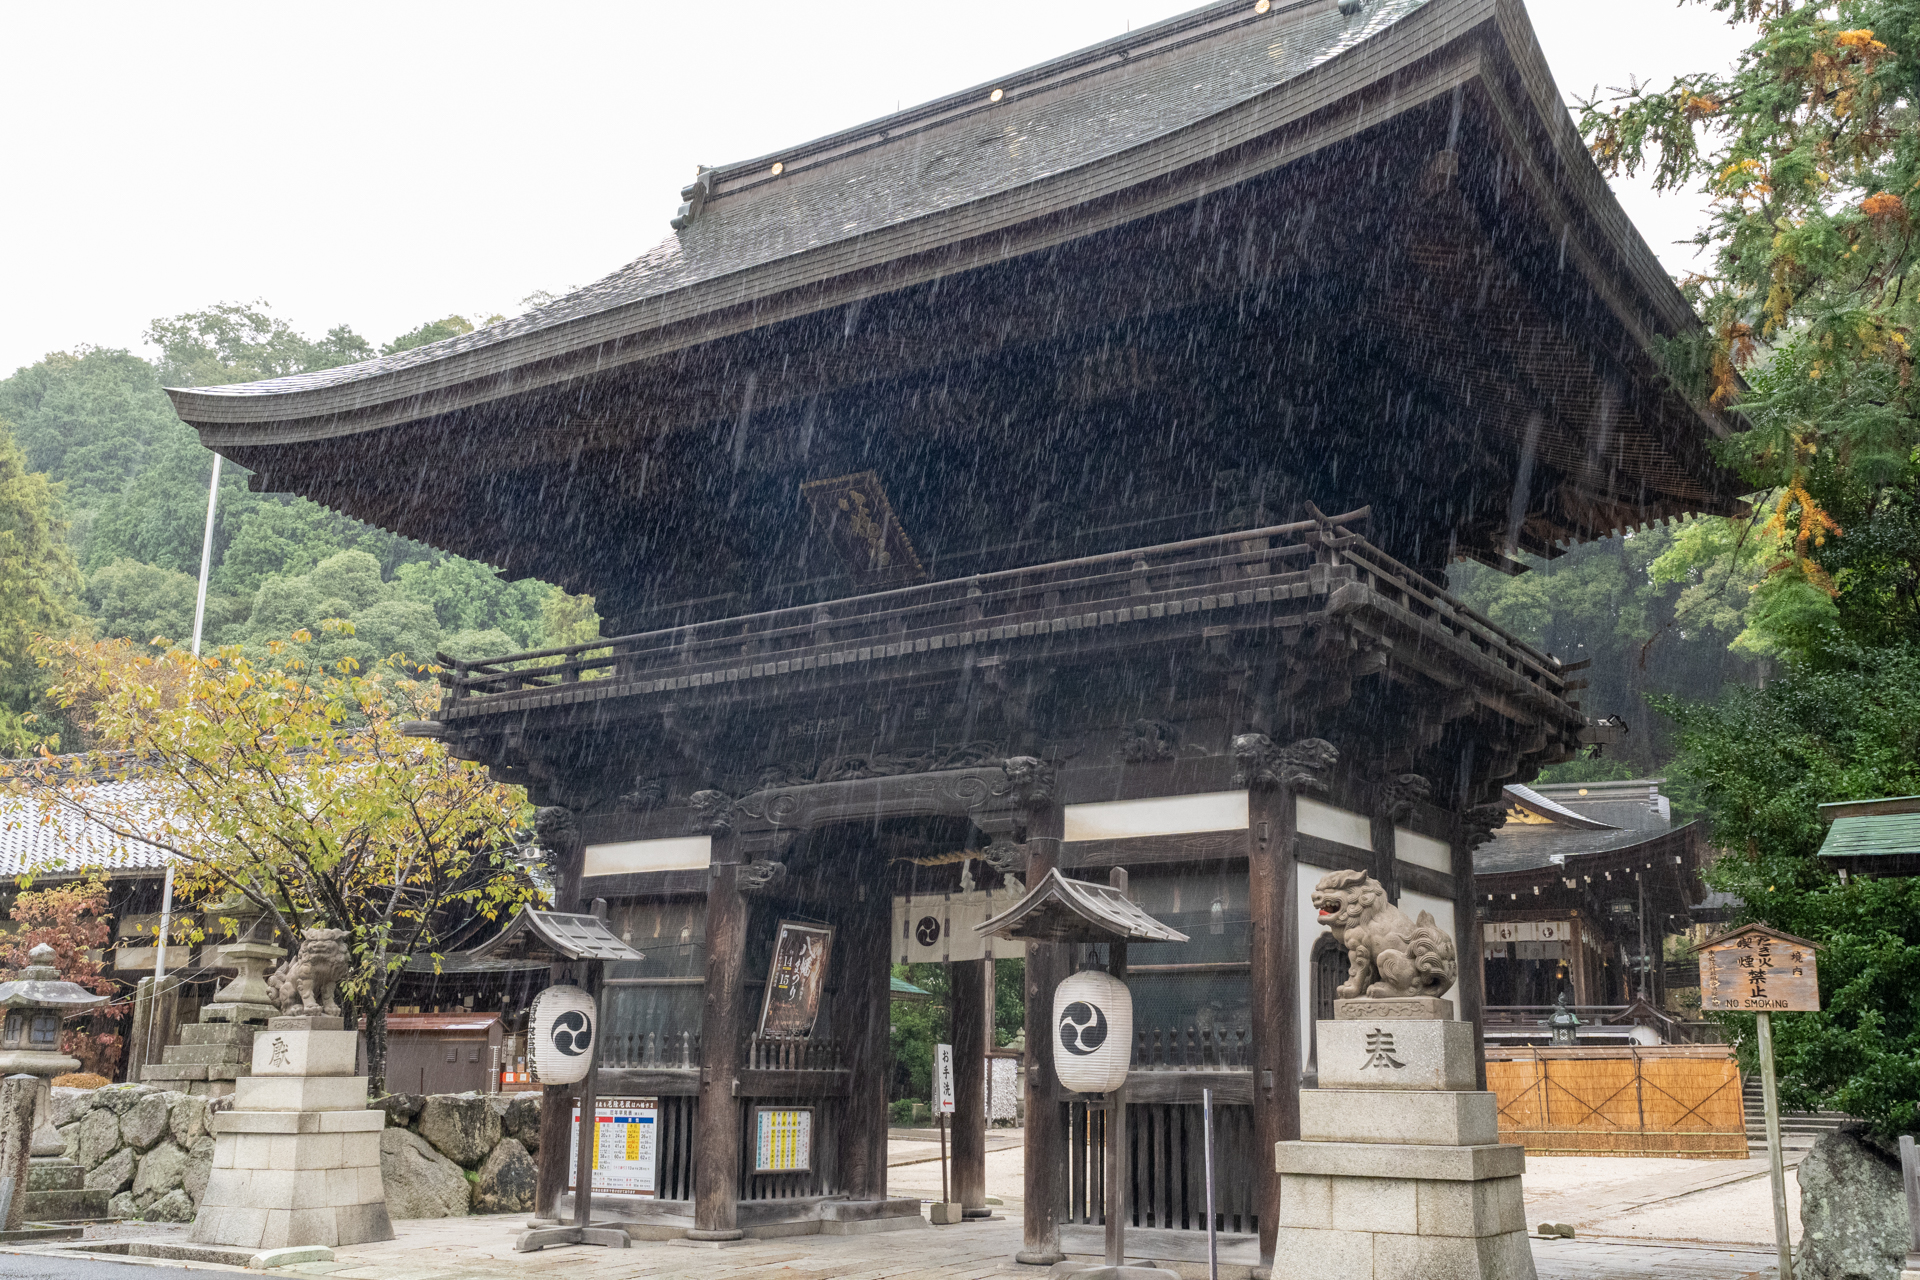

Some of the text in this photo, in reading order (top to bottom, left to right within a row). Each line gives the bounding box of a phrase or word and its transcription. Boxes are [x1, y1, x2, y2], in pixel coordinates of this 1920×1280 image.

[783, 956, 792, 967] 14
[1737, 937, 1754, 968] 喫煙
[1757, 935, 1774, 968] たき火
[1791, 951, 1803, 976] 境内
[779, 974, 789, 985] 15
[1748, 969, 1767, 998] 禁止
[1726, 999, 1789, 1009] NO SMOKING
[1359, 1028, 1407, 1071] 奉
[942, 1050, 951, 1097] お手洗
